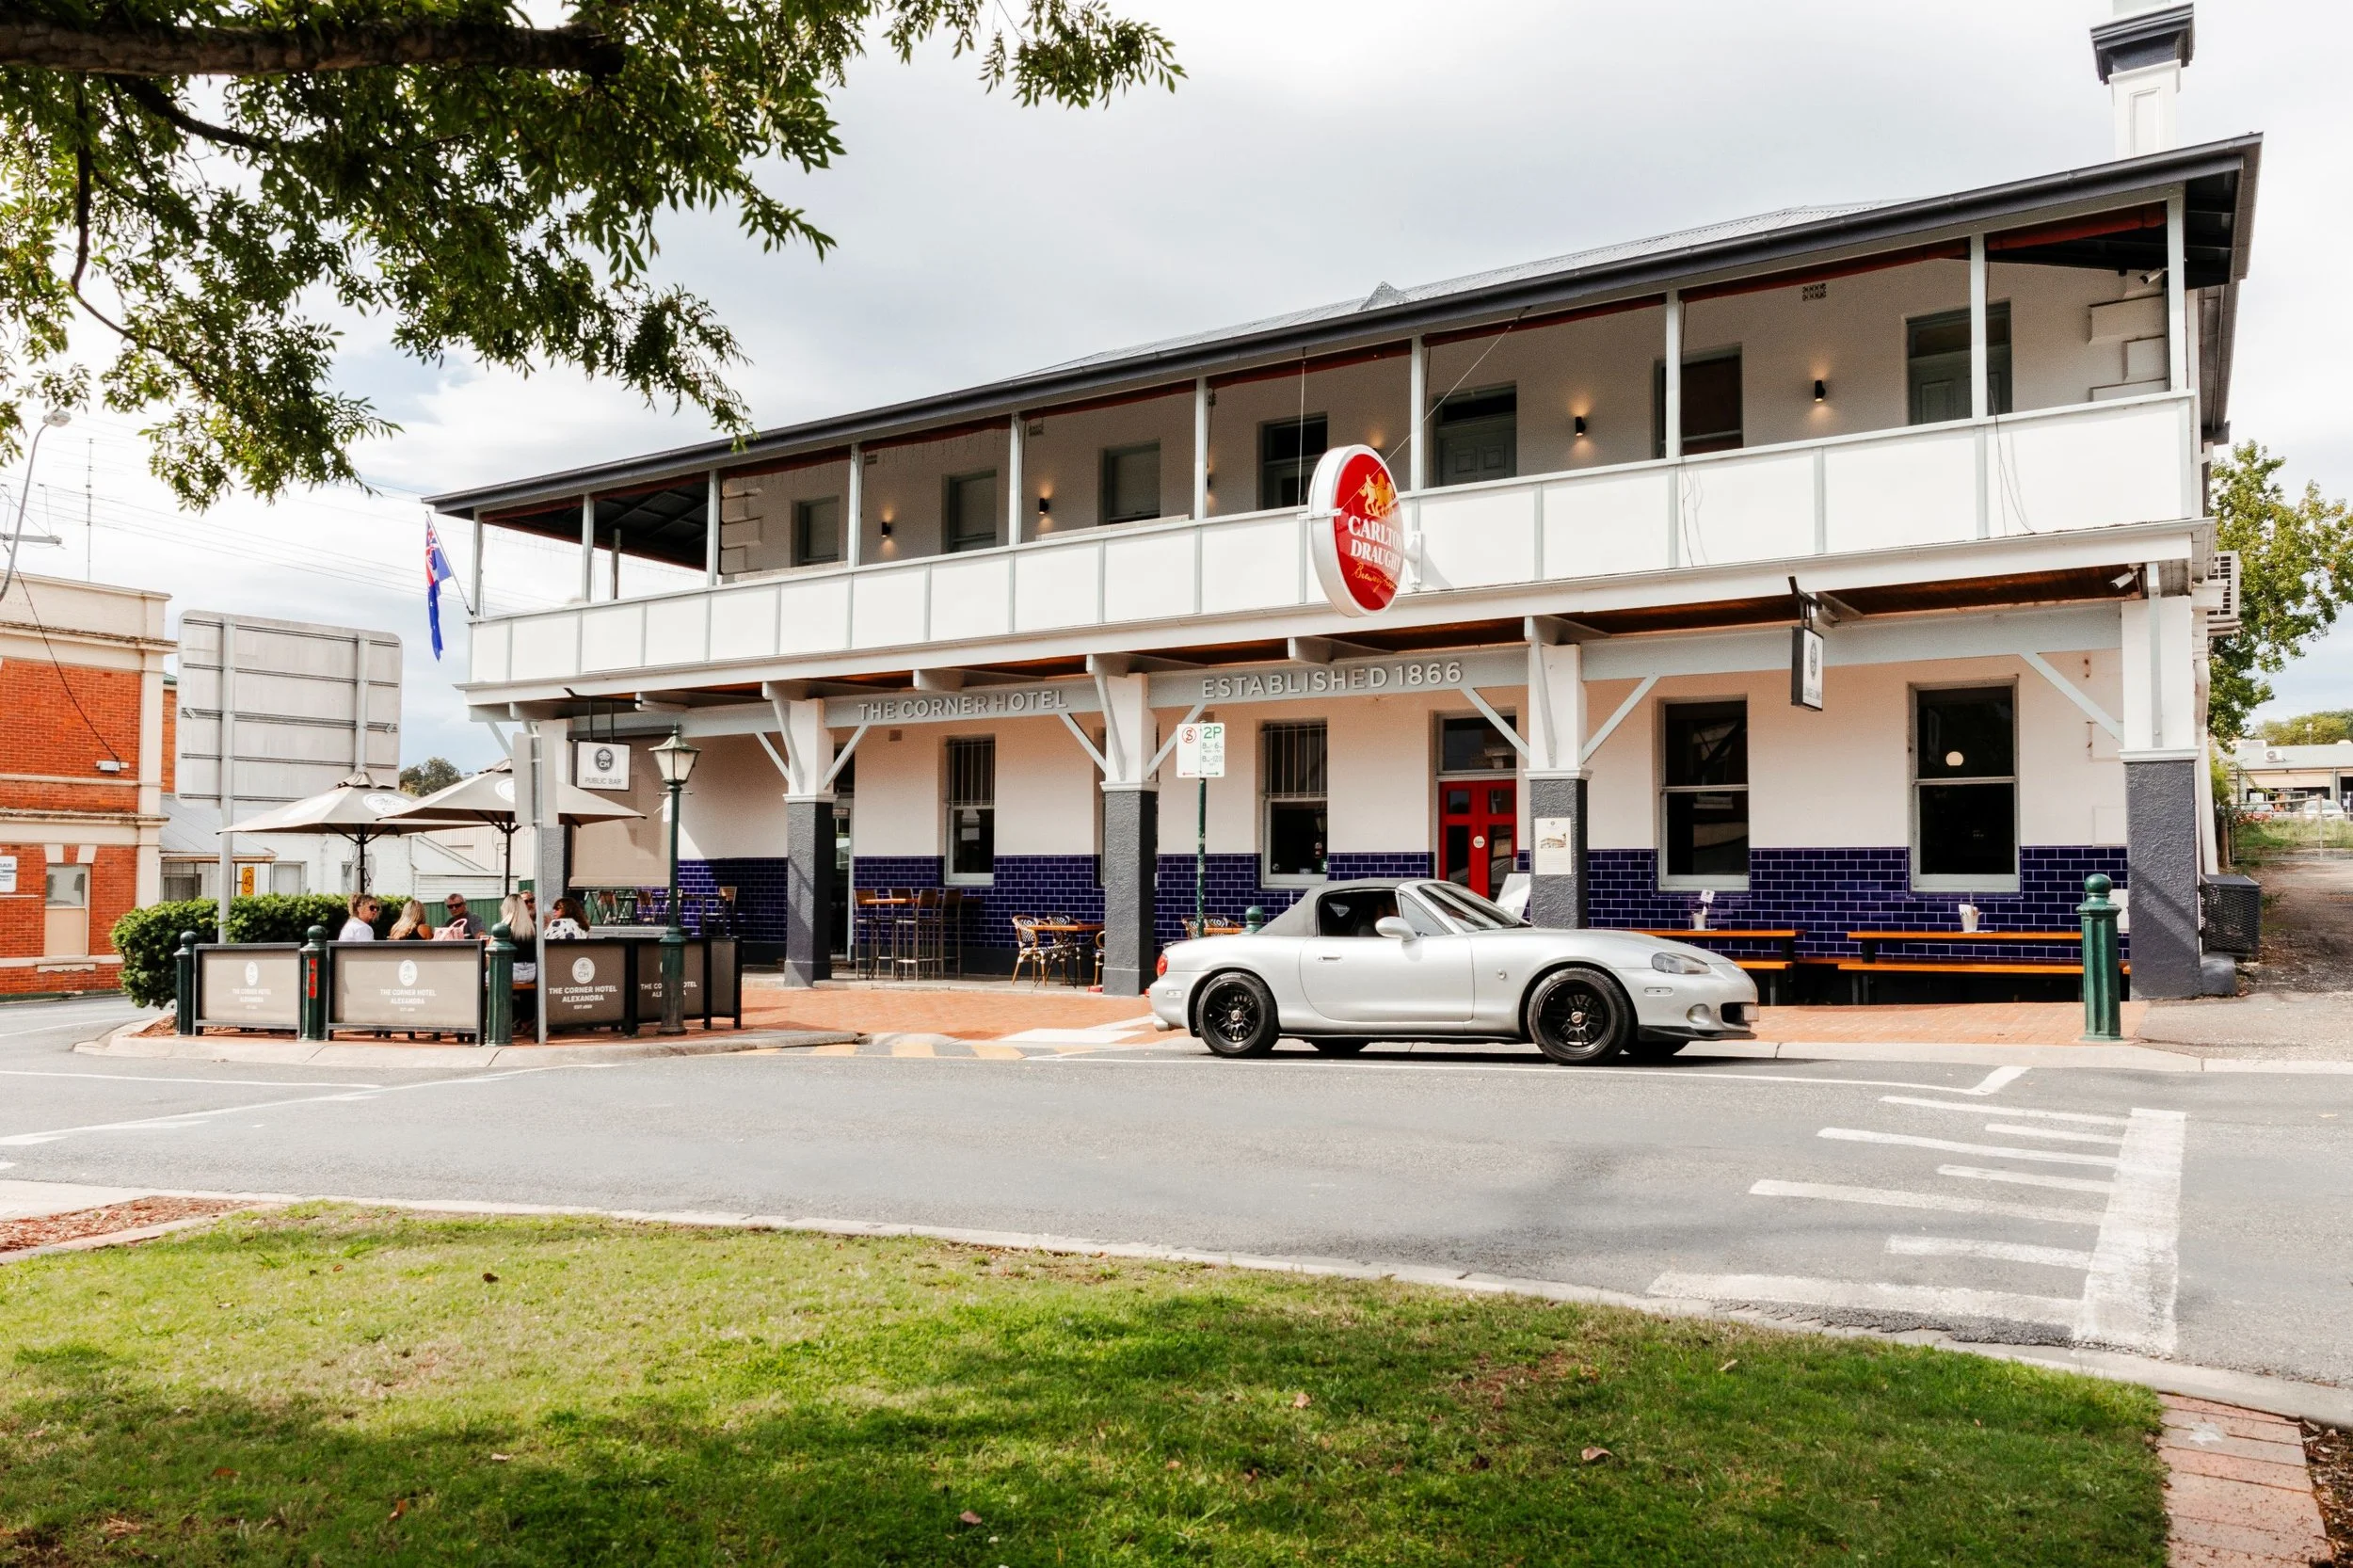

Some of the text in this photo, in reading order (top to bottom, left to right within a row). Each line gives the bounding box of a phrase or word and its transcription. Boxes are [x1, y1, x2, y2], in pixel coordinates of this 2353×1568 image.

[1348, 515, 1402, 552] CARLTON
[1350, 538, 1401, 573] DRAUGHT
[1202, 661, 1463, 698] ESTABLISHED 1866
[858, 690, 1068, 720] THE CORNER HOTEL
[1204, 727, 1222, 739] 2P
[584, 776, 607, 785] PUBLIC
[417, 988, 437, 997] HOTEL
[595, 984, 617, 993] HOTEL
[562, 995, 604, 1003] ALEXANDRA
